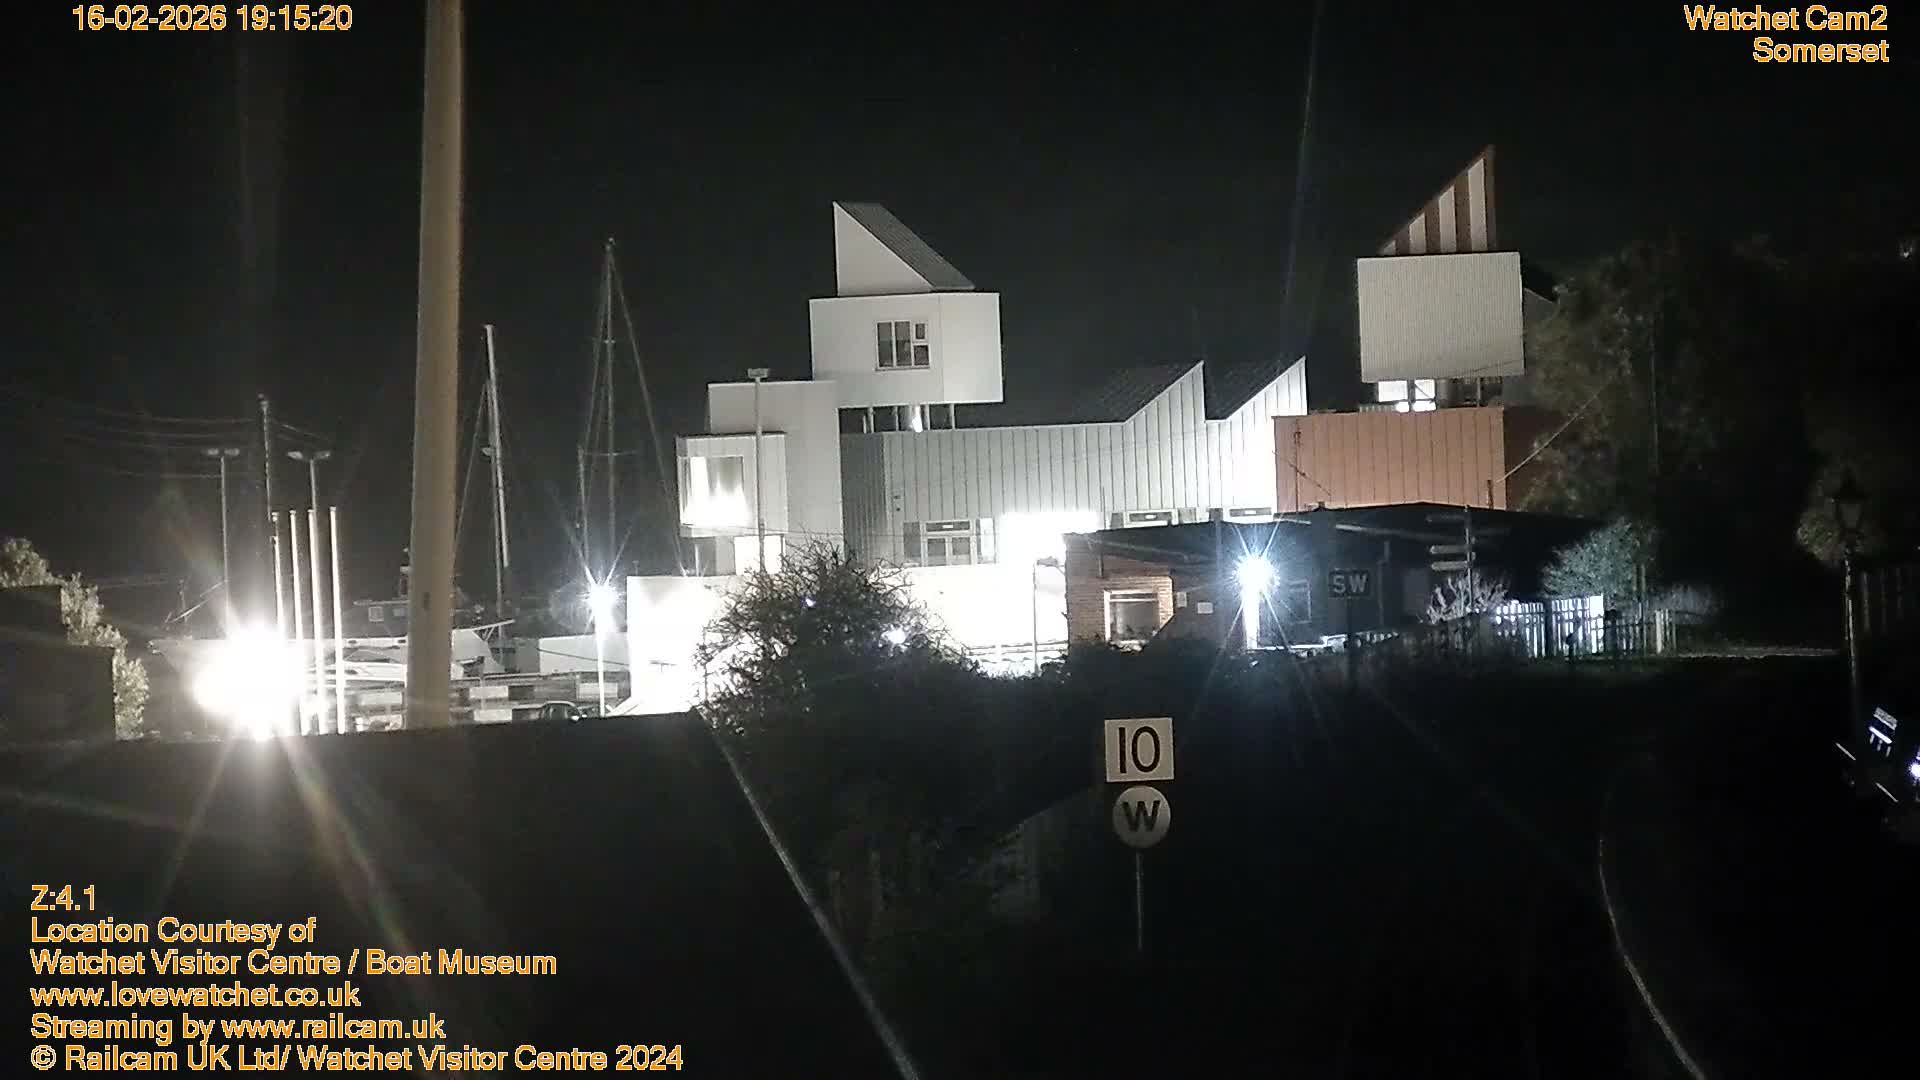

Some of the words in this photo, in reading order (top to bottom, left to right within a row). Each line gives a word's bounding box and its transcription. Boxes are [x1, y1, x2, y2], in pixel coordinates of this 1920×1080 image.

[1333, 573, 1367, 593] SW
[1118, 726, 1161, 774] 10
[1122, 800, 1161, 832] W
